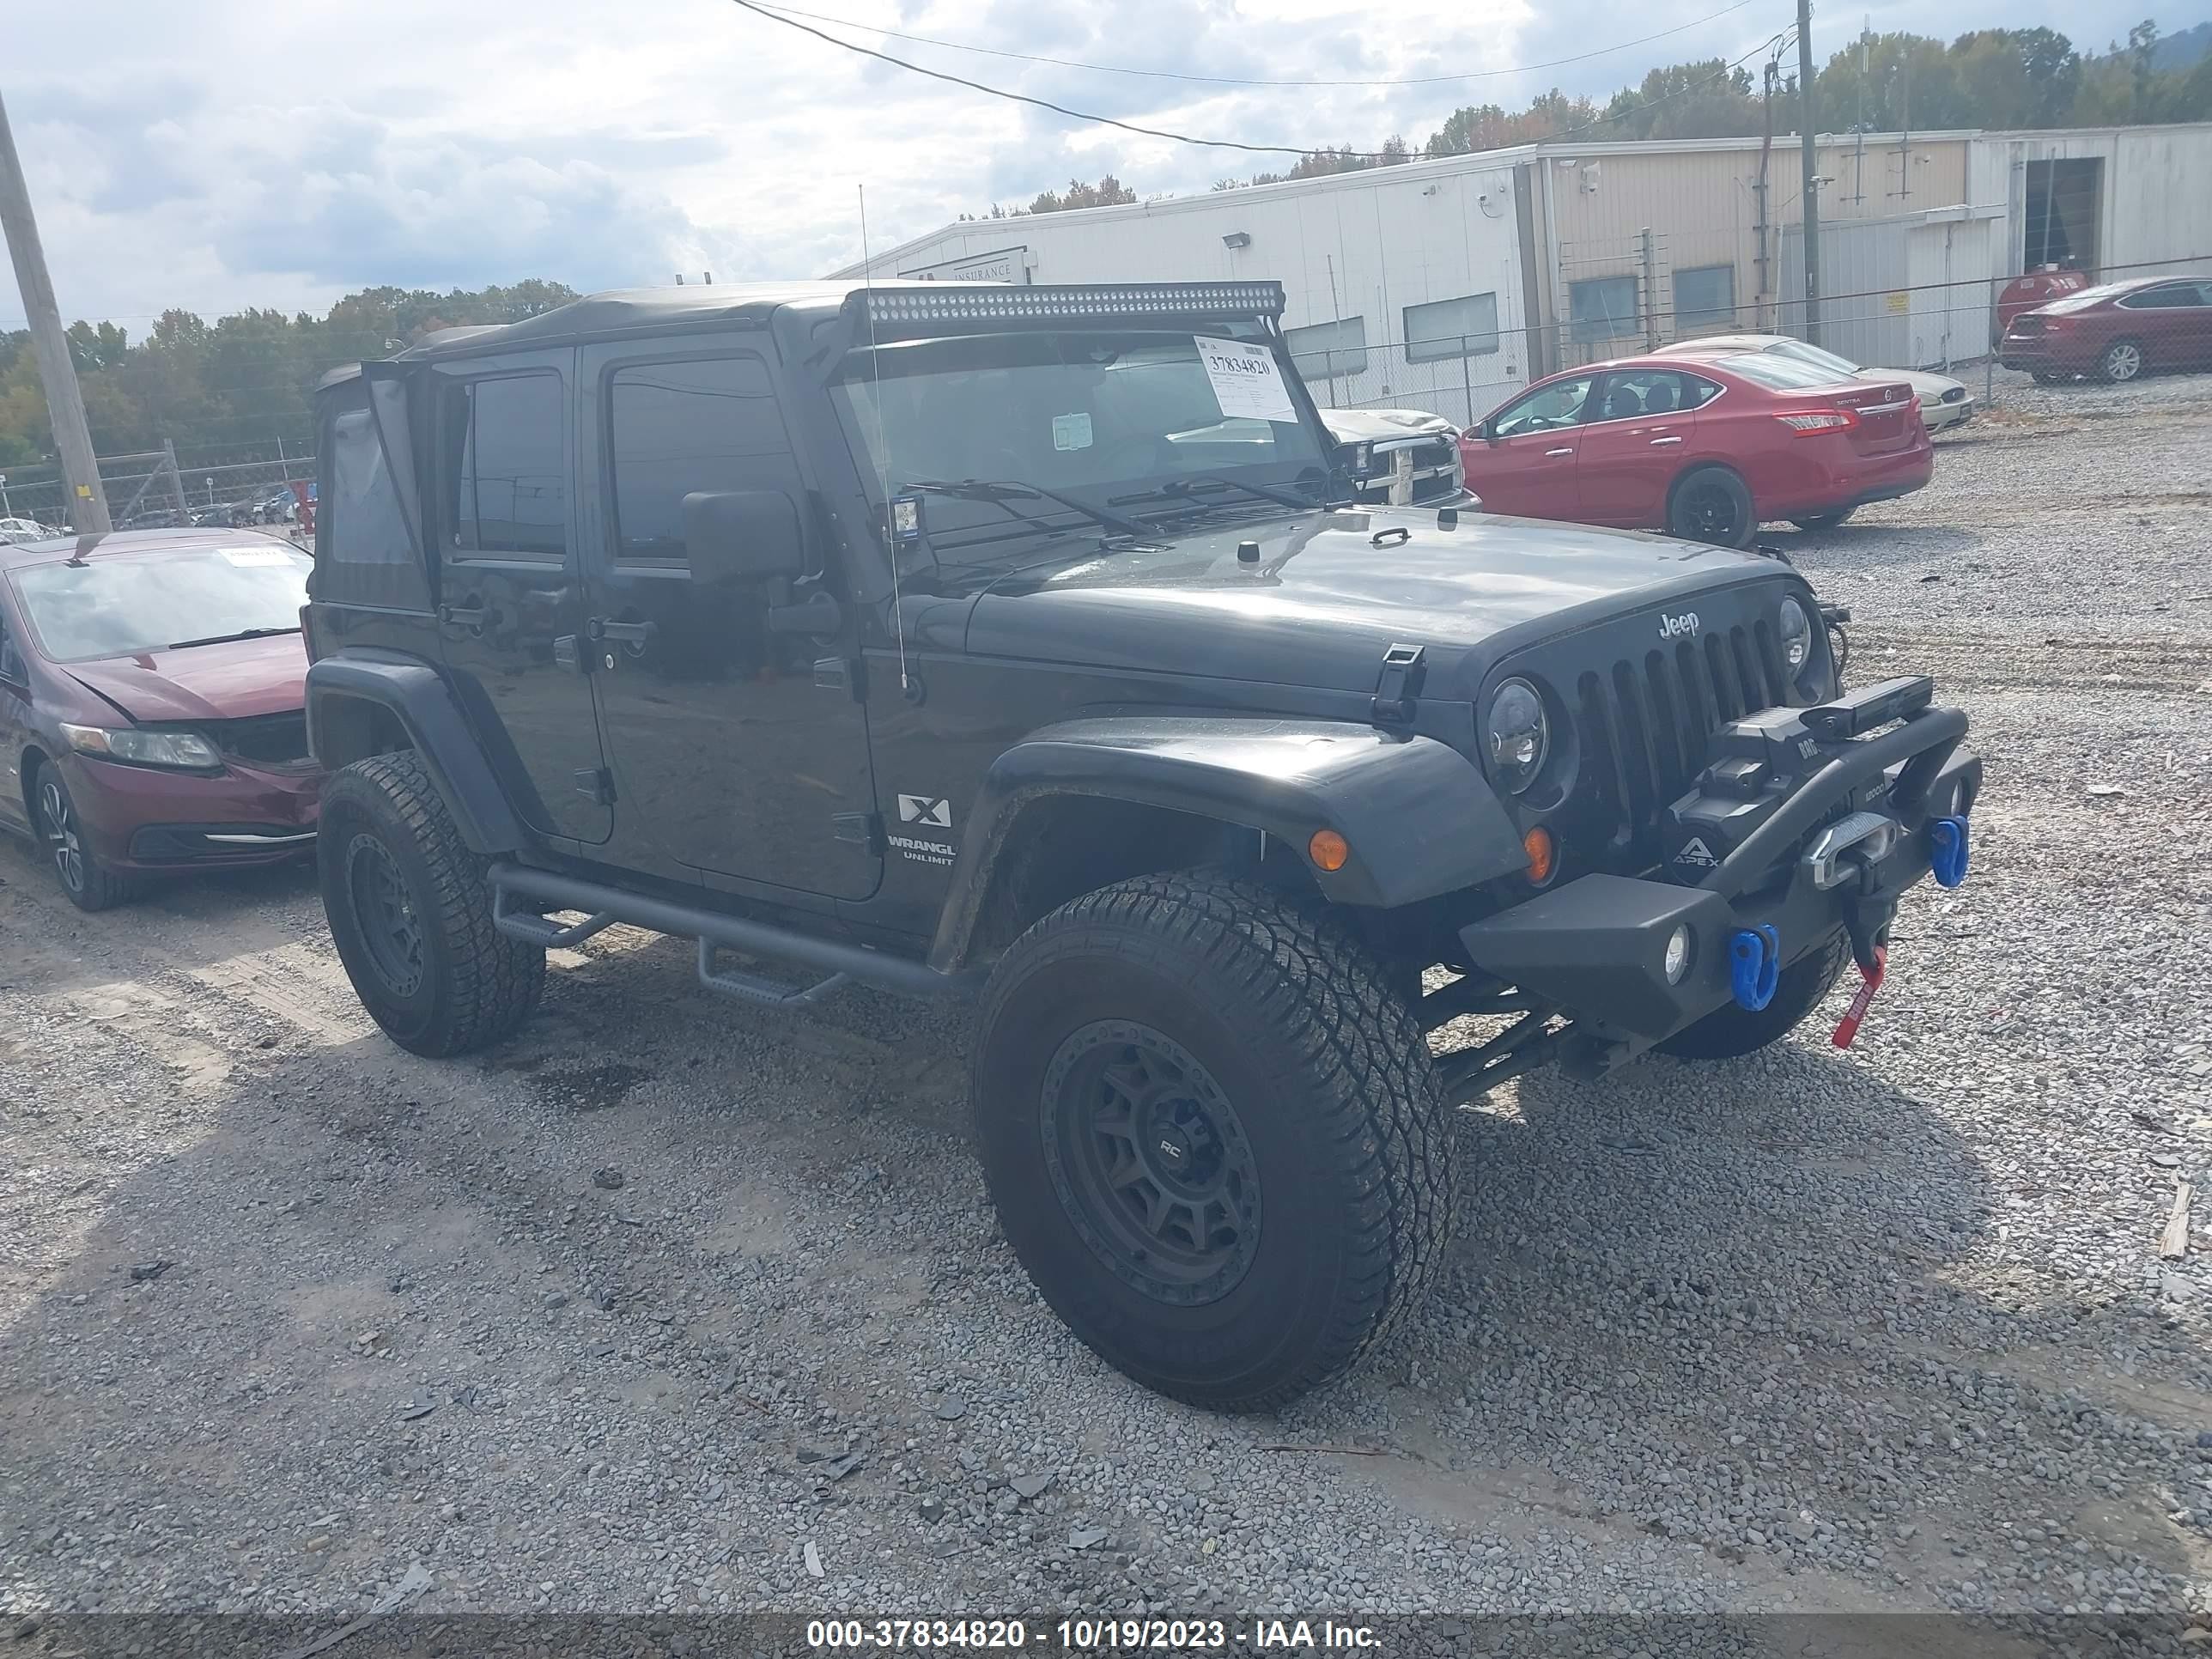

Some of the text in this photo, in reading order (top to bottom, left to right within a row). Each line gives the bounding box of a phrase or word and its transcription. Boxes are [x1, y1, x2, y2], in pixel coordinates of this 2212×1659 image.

[955, 264, 1011, 282] INSURANCE
[1209, 356, 1271, 375] 37834820
[1658, 612, 1699, 639] Jeep
[1797, 738, 1821, 760] BAD
[887, 835, 957, 856] WRANGL
[903, 851, 954, 866] UNLIMIT
[1672, 854, 1720, 867] APEX
[1160, 1139, 1182, 1158] RC
